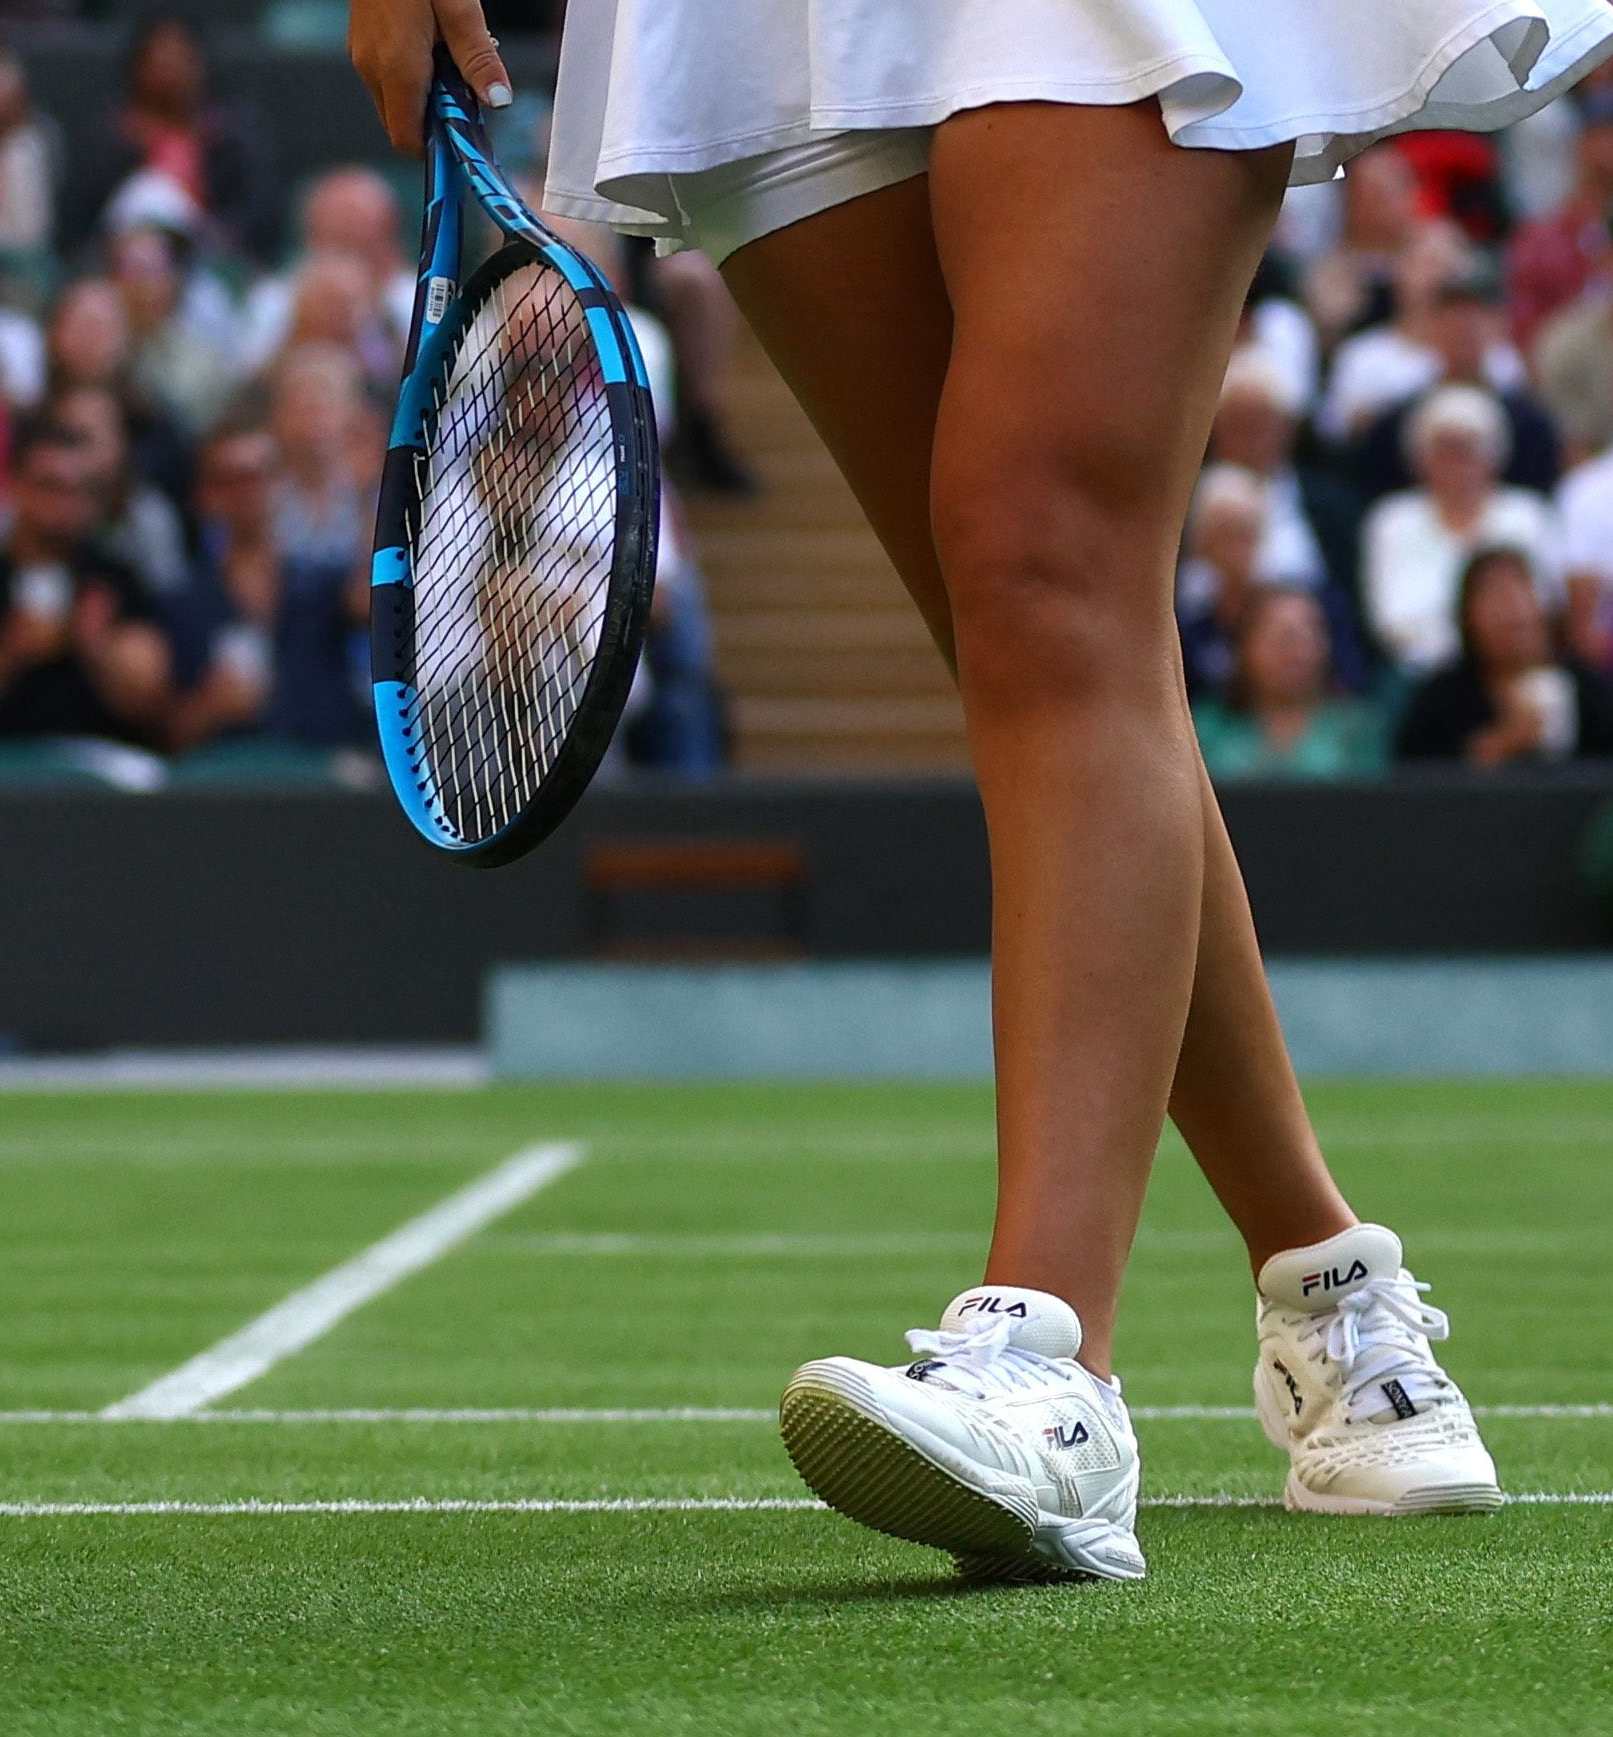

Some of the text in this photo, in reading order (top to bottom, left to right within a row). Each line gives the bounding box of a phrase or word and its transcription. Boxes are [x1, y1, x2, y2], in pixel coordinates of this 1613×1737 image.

[1301, 1259, 1368, 1297] FILA
[958, 1296, 1027, 1318] FILA
[1043, 1420, 1089, 1451] FILA
